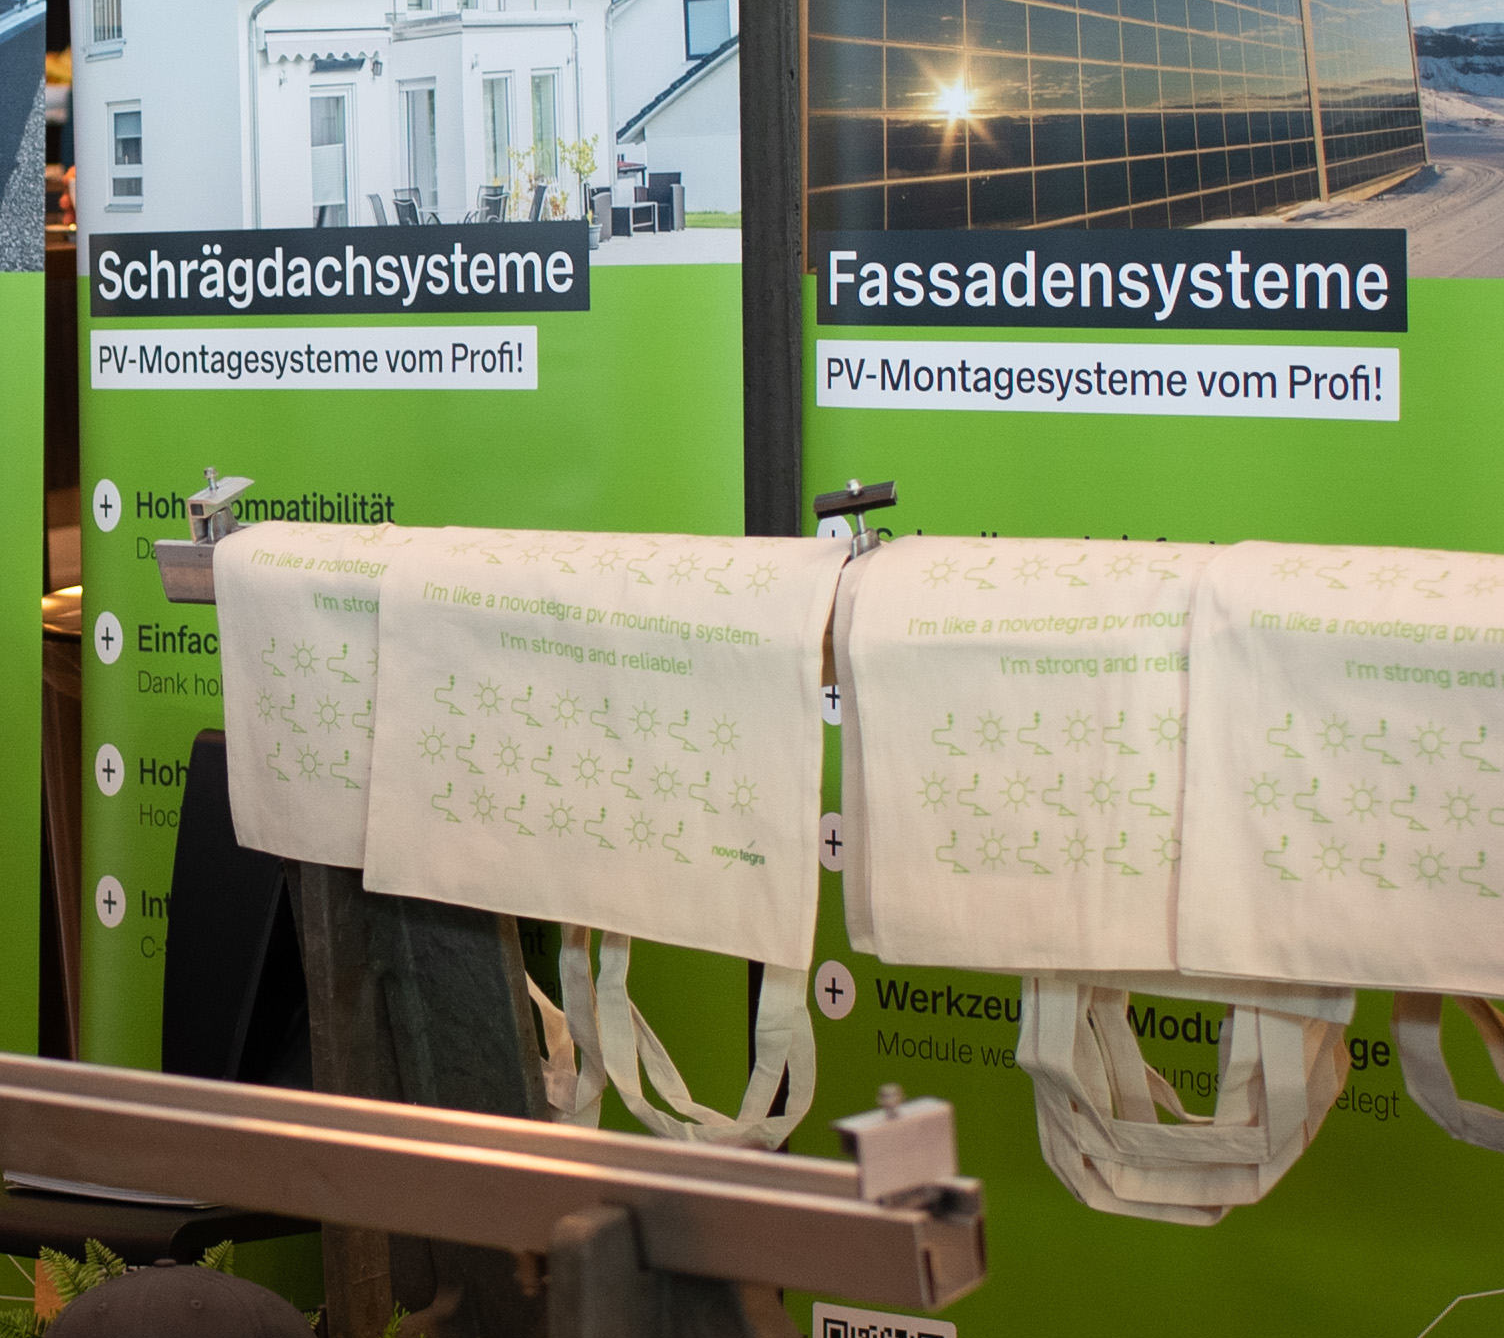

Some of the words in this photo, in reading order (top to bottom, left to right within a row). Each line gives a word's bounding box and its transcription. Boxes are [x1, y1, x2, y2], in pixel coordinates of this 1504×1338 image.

[98, 242, 574, 309] Schrägdachsysteme
[828, 249, 1389, 321] Fassadensysteme
[98, 344, 378, 380] PV-Montagesysteme
[386, 345, 443, 373] vom
[451, 342, 524, 373] Profi!
[827, 356, 1188, 402] PV-Montagesysteme
[1196, 366, 1278, 399] vom
[1289, 363, 1382, 402] Profi!
[137, 492, 186, 519] Hoh
[231, 492, 395, 522] ompatibilität
[453, 584, 481, 607] like
[486, 592, 495, 607] a
[500, 594, 582, 624] novotegra
[587, 607, 606, 625] pv
[610, 608, 690, 639] mounting
[694, 619, 759, 647] system
[942, 614, 977, 634] like
[981, 619, 993, 633] a
[998, 614, 1098, 635] novotegra
[1103, 614, 1128, 633] pv
[1286, 612, 1321, 633] like
[1326, 618, 1337, 632] a
[1343, 618, 1447, 643] novotegra
[1454, 624, 1479, 643] pv
[138, 624, 219, 656] Einfac
[530, 635, 583, 665] strong
[589, 641, 617, 664] and
[622, 646, 693, 676] reliable!
[1036, 657, 1097, 678] strong
[1105, 655, 1136, 674] and
[1385, 664, 1452, 689] strong
[1458, 667, 1495, 688] and
[138, 670, 187, 696] Dank
[712, 844, 765, 866] novotegra
[876, 1029, 972, 1064] Module
